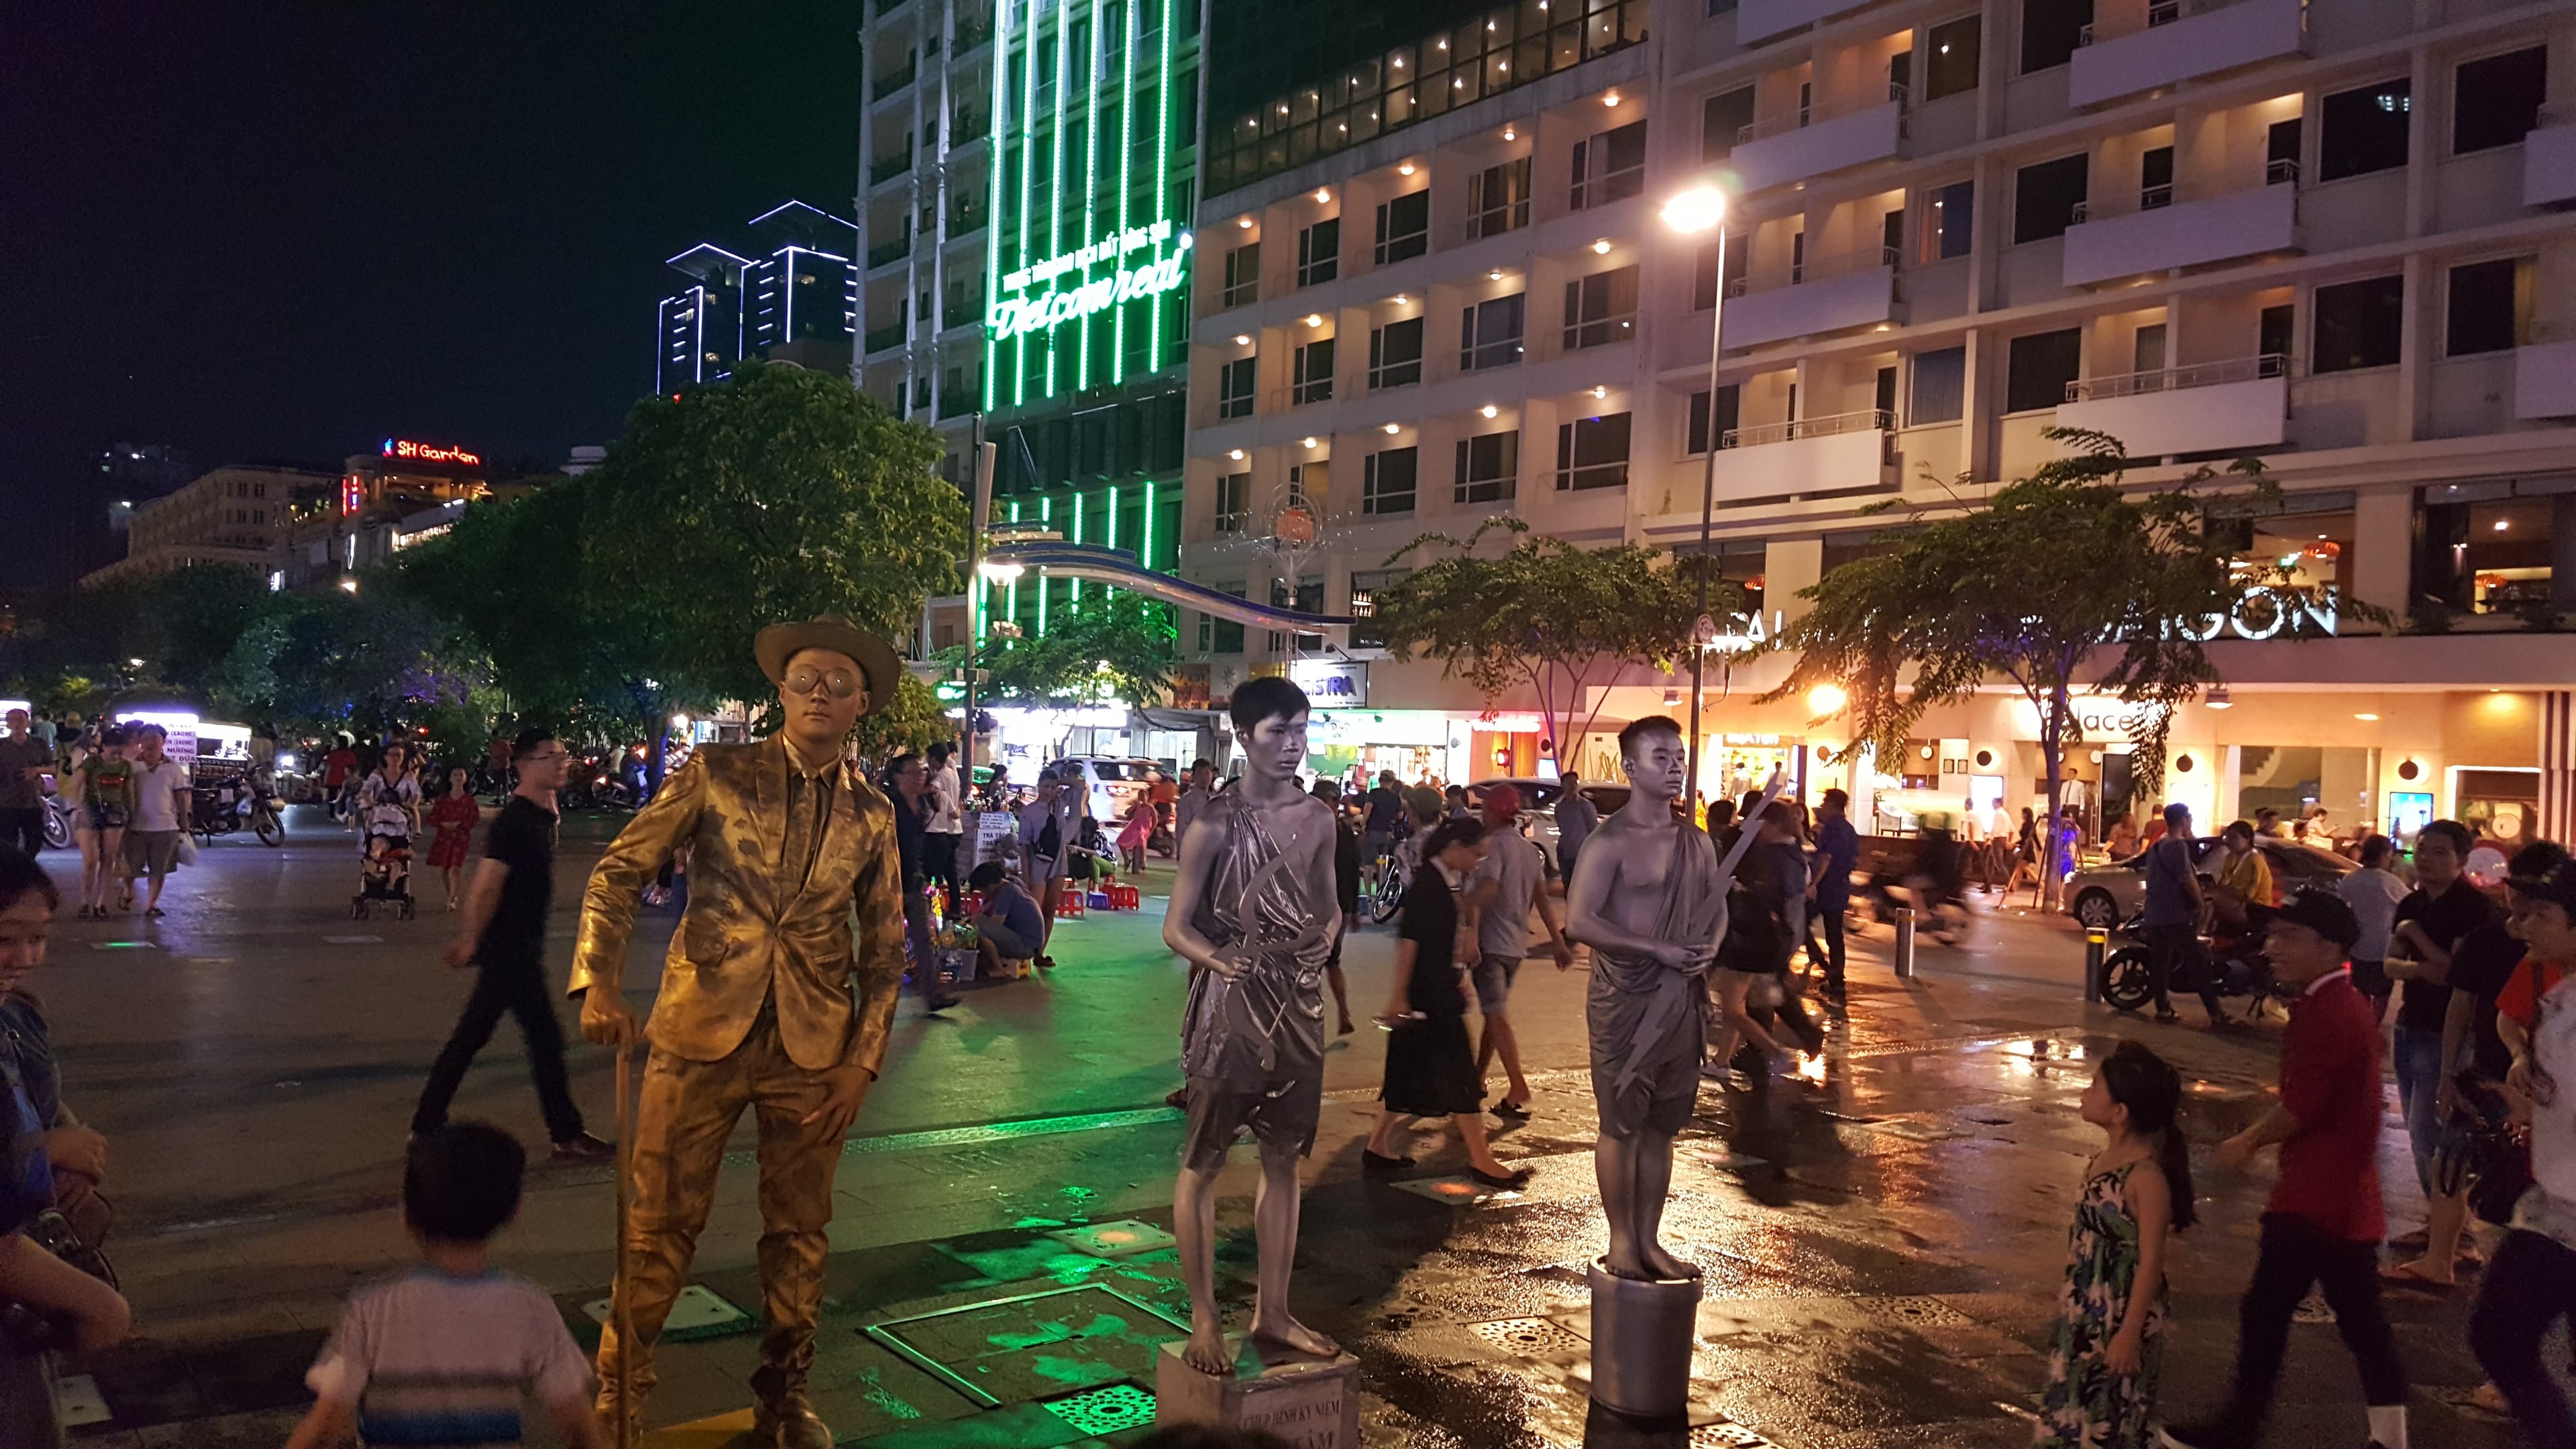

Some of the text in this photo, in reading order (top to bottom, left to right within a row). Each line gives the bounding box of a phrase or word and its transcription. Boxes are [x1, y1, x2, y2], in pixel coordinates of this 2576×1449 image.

[398, 441, 480, 466] SH Garden
[2084, 585, 2339, 642] AIGON
[2077, 705, 2135, 732] lace
